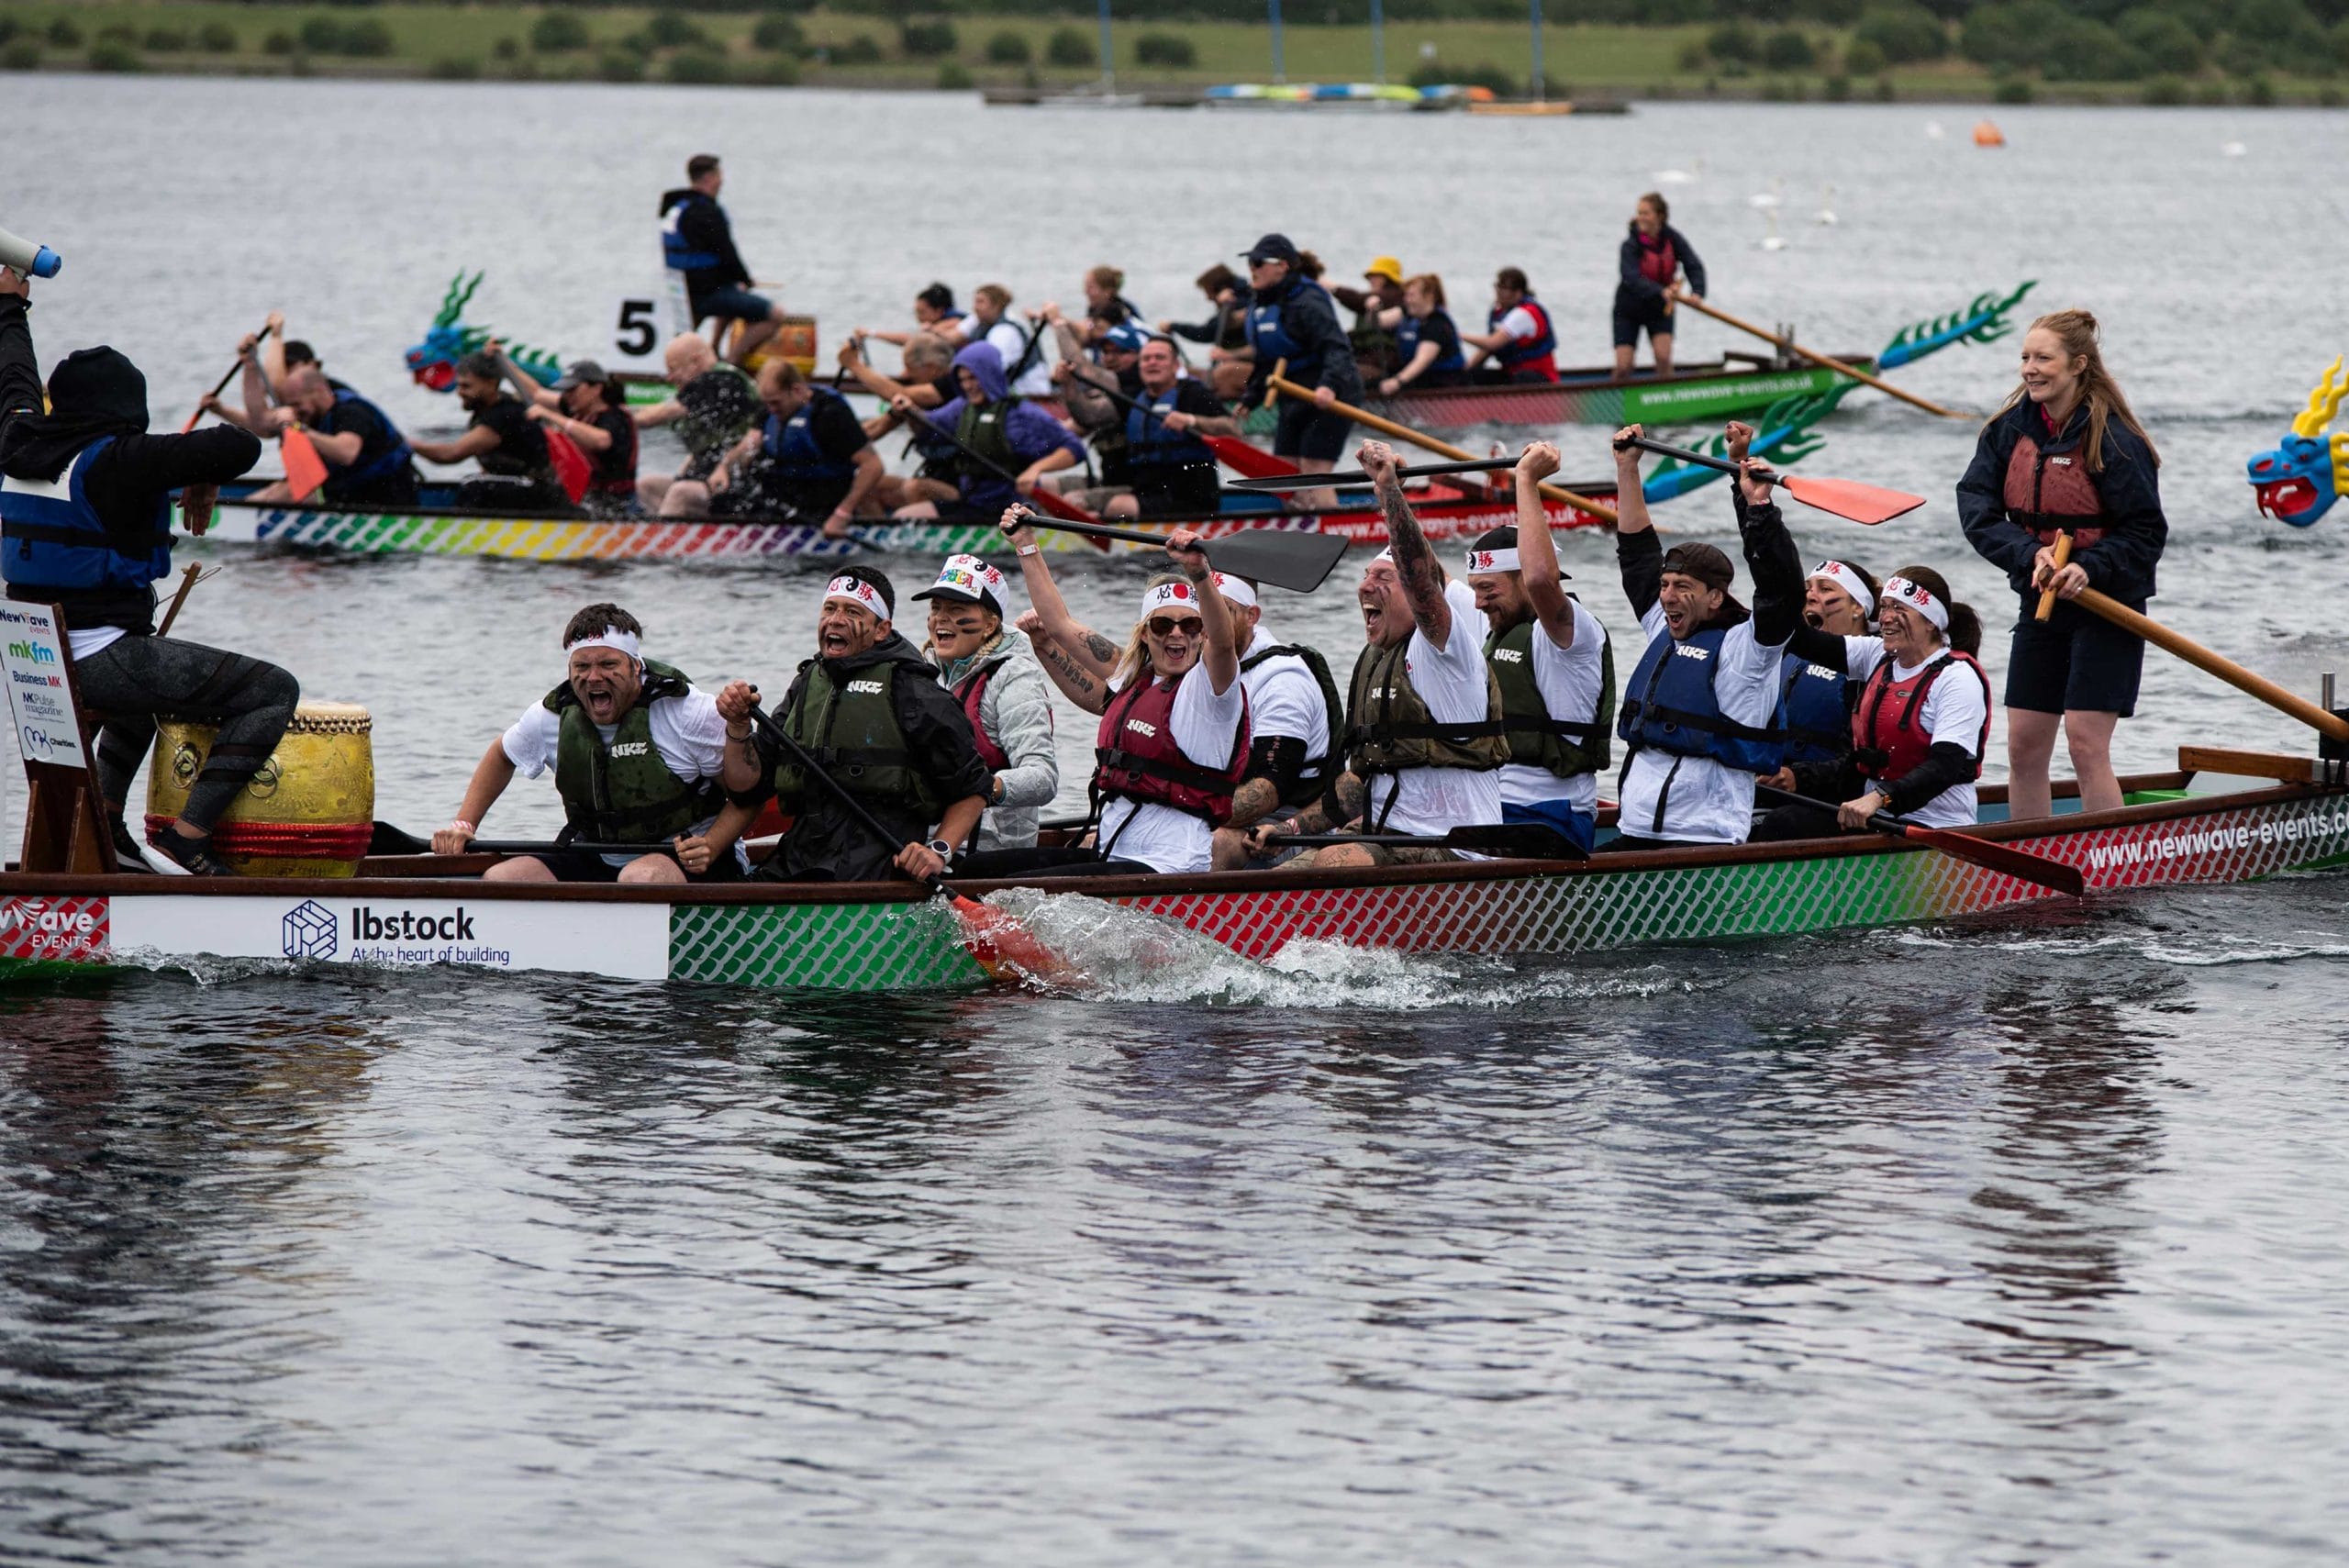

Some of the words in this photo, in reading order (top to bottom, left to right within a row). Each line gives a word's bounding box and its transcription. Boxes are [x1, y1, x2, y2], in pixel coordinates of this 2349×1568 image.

[616, 300, 656, 357] 5
[29, 626, 50, 636] EVENTS
[9, 639, 54, 664] mkfm
[12, 670, 48, 686] Business
[48, 675, 62, 688] MK
[25, 704, 63, 717] magazine
[2088, 812, 2349, 869] www.newwave-events.c
[352, 906, 475, 940] Ibstock
[32, 935, 92, 949] EVENTS
[351, 947, 367, 962] At
[397, 946, 435, 962] heart
[438, 946, 453, 962] of
[456, 947, 509, 966] building
